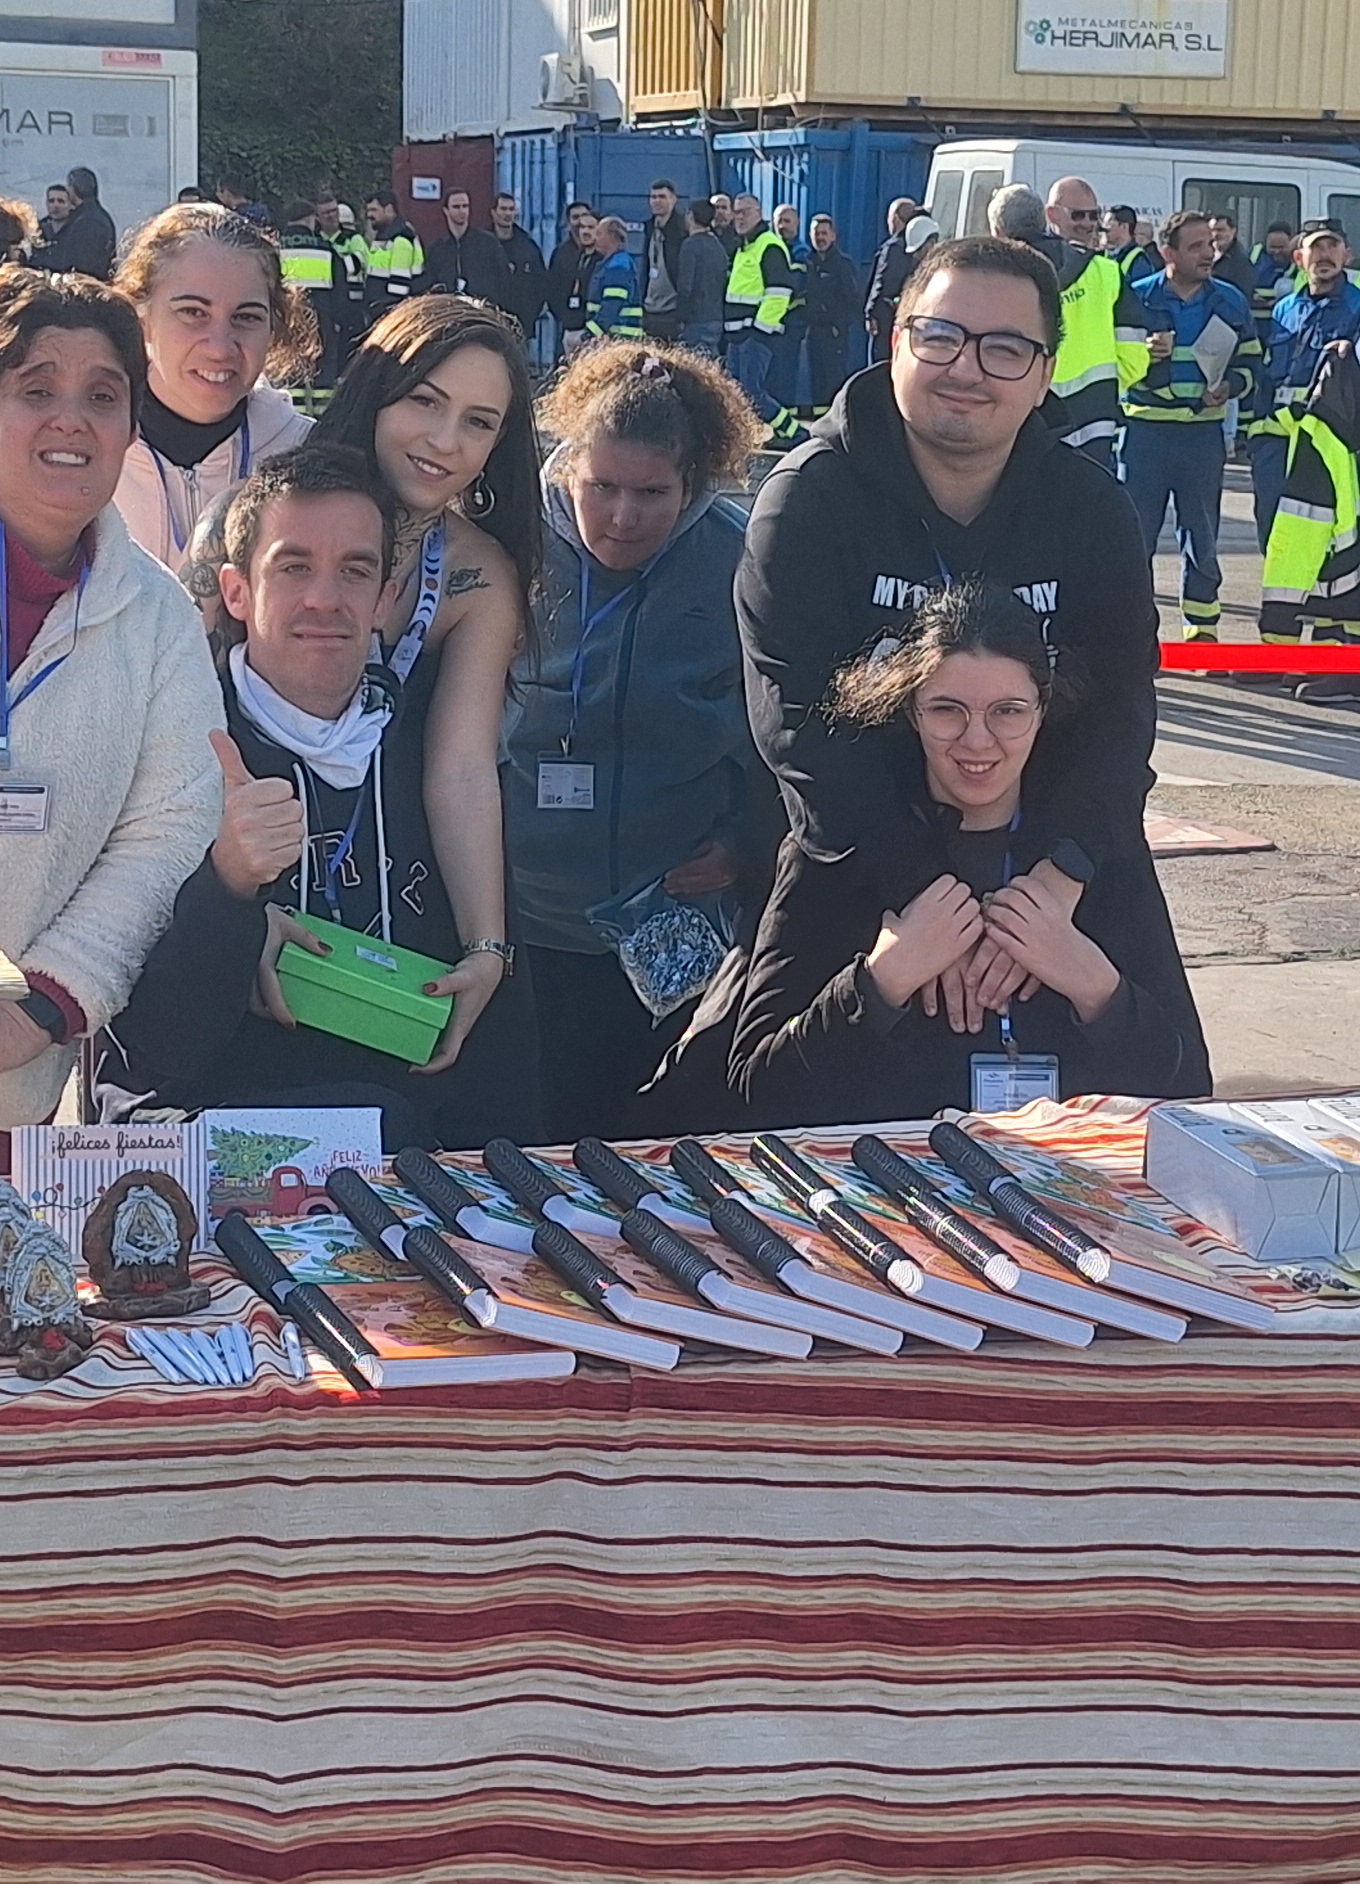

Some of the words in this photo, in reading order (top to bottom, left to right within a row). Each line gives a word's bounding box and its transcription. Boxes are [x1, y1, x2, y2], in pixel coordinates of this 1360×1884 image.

[1057, 17, 1193, 31] METALMECANICAS
[1050, 30, 1179, 52] HERJIMAR,
[872, 575, 909, 610] MY
[51, 1131, 111, 1159] ¡felices
[116, 1131, 181, 1158] fiestas!
